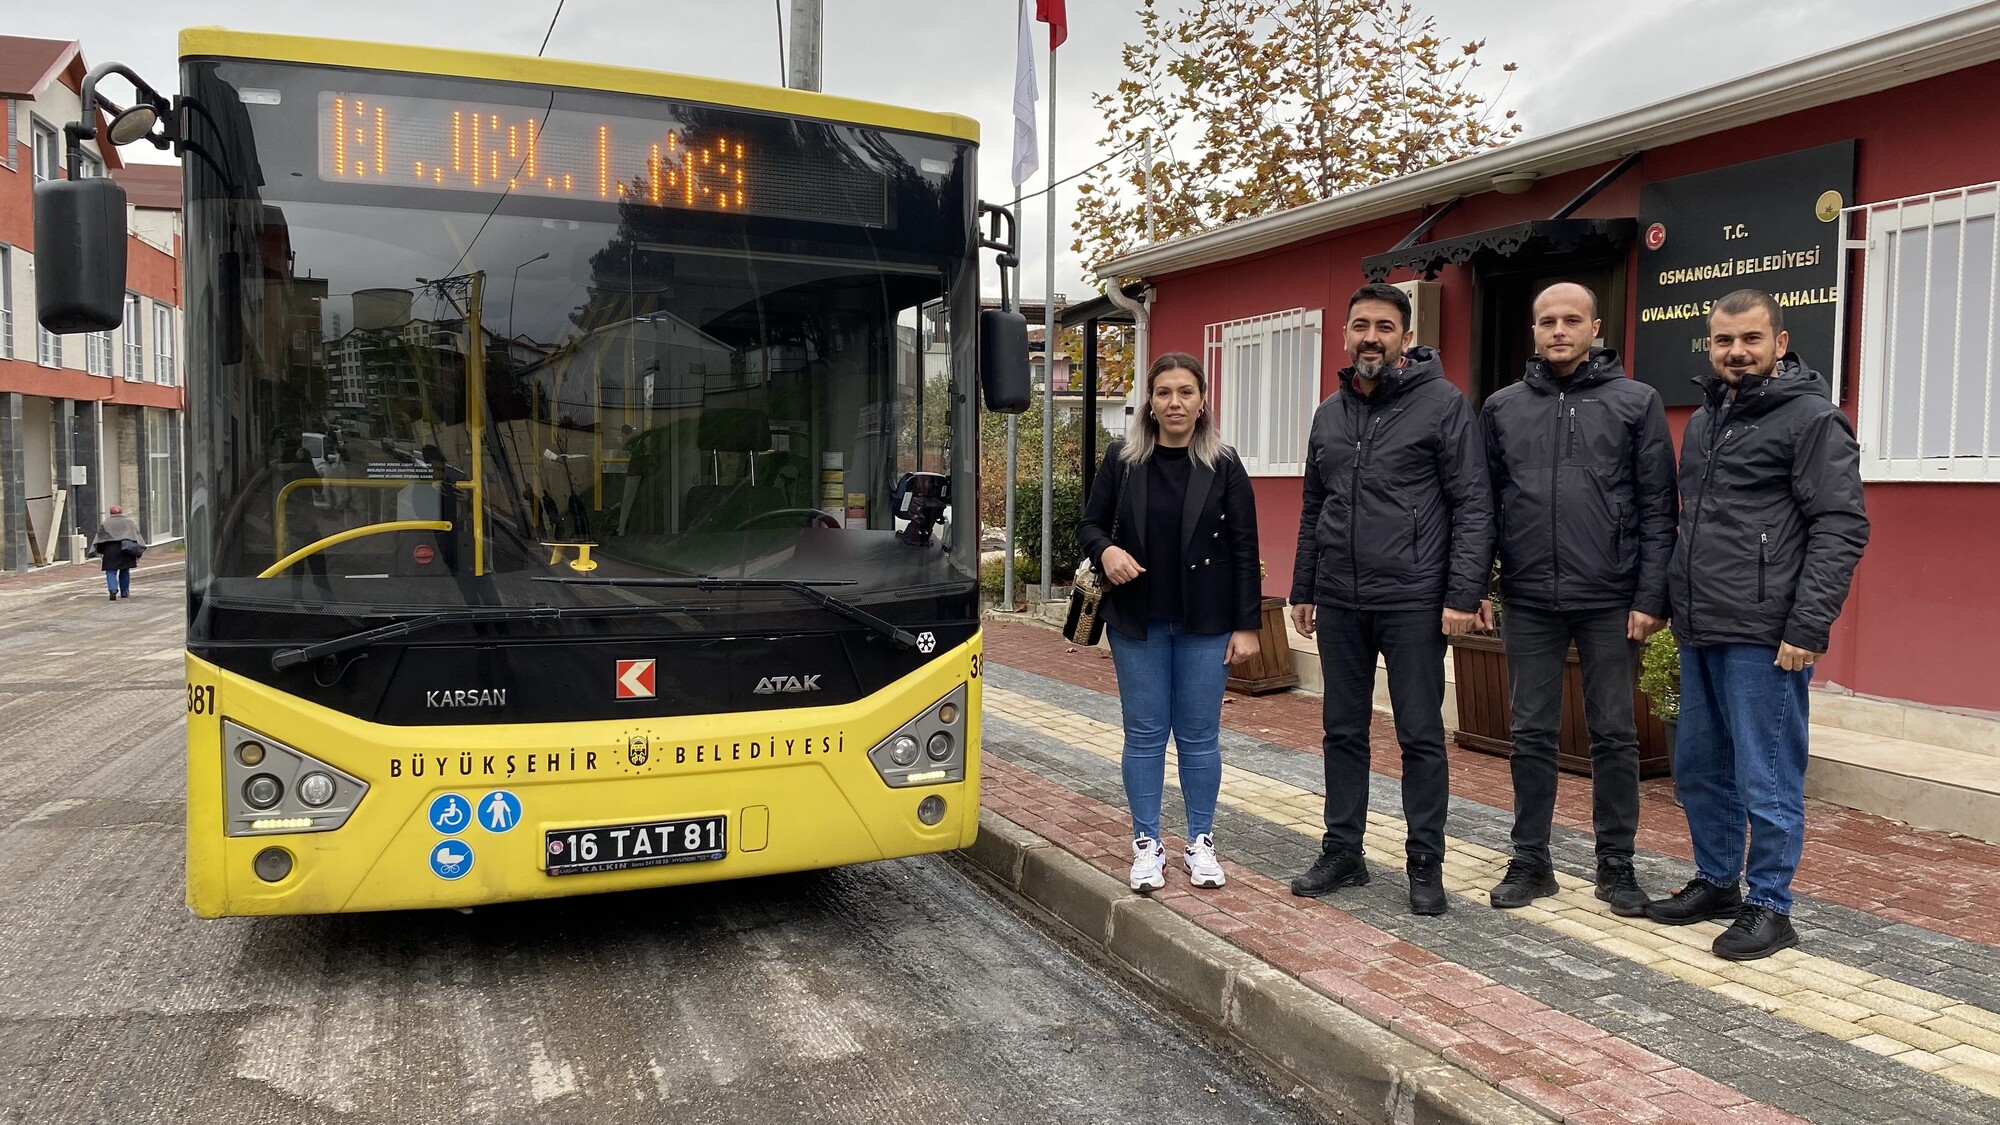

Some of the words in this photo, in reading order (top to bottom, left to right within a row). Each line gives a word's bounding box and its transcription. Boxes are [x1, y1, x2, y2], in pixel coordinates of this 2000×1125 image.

[1723, 223, 1749, 241] T.C.
[1659, 258, 1734, 285] OSMANGAZİ
[1736, 245, 1821, 275] BELEDİYESİ
[1641, 303, 1700, 323] OVAAKÇA
[753, 674, 822, 694] ATAK
[187, 682, 215, 715] 381
[426, 688, 506, 708] KARSAN
[390, 747, 598, 778] BÜYÜKŞEHİR
[675, 731, 845, 764] BELEDİYESİ
[566, 833, 599, 862] 16
[609, 826, 675, 858] TAT
[684, 821, 716, 850] 81
[581, 862, 627, 873] KALKIN
